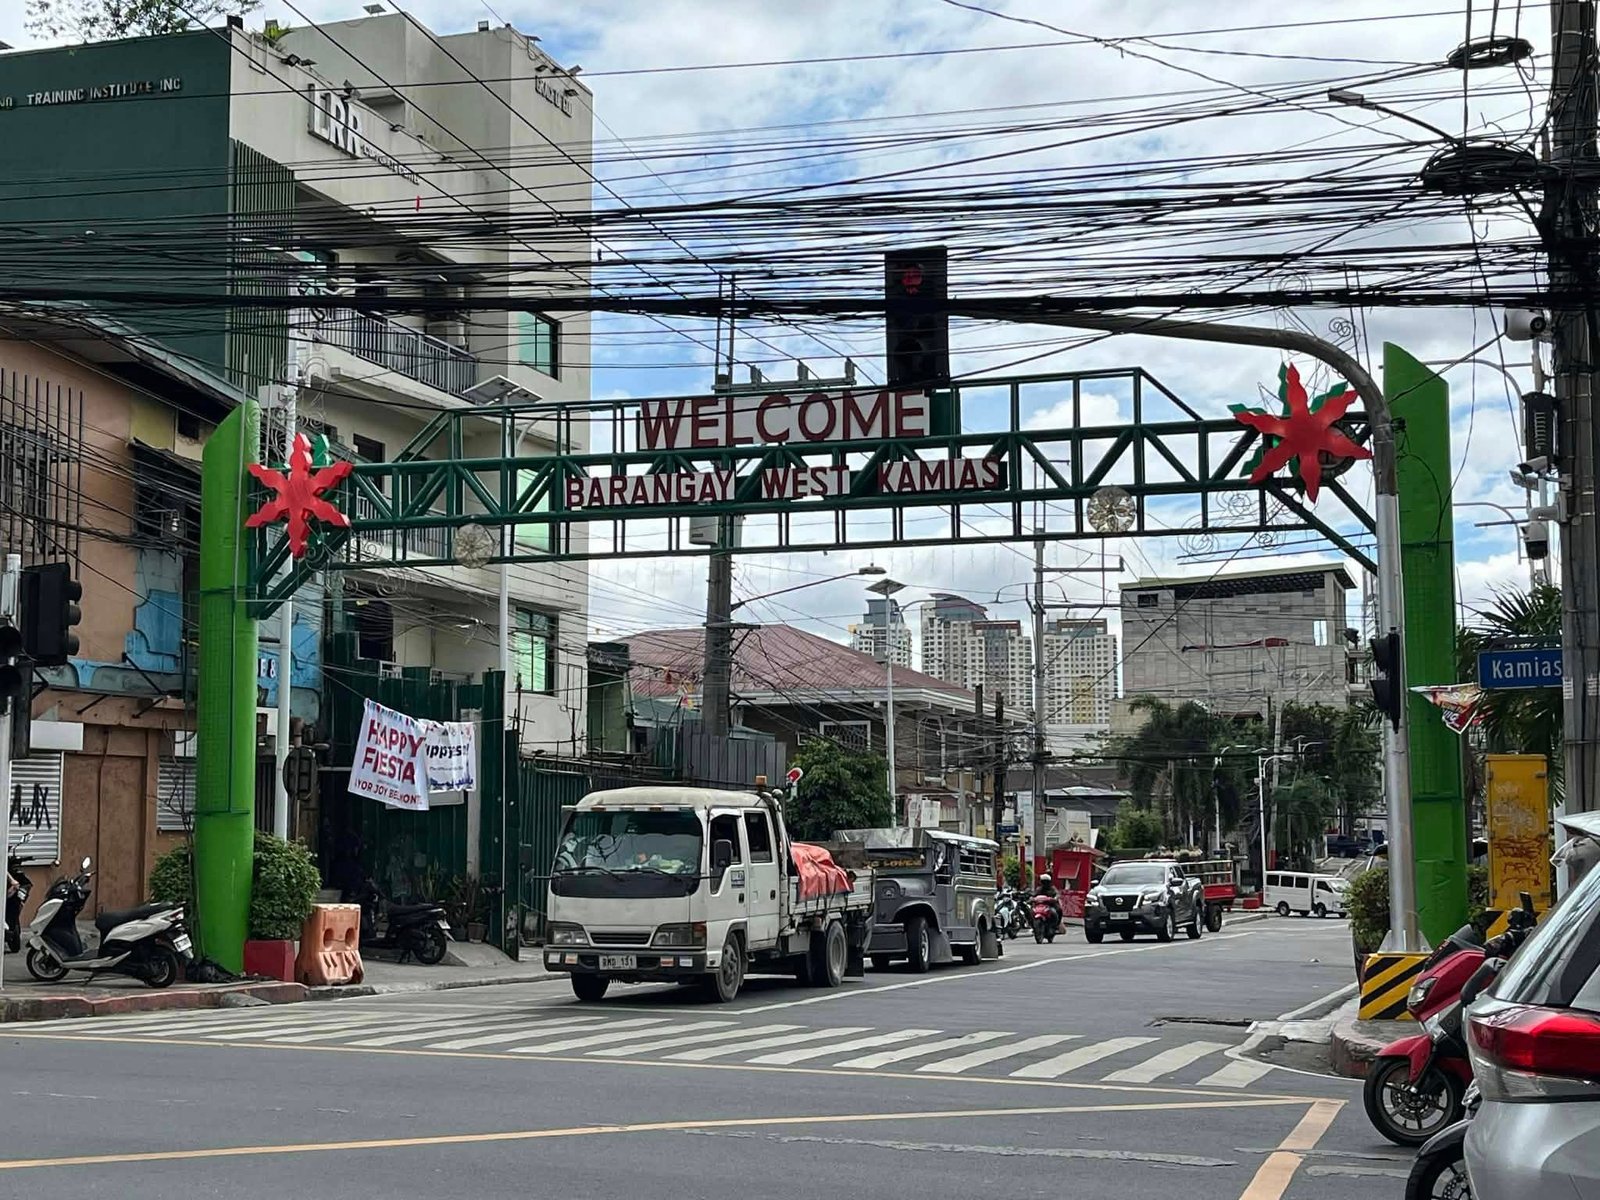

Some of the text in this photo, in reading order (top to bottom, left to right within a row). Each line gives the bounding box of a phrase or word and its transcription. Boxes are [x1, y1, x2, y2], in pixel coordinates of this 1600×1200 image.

[641, 388, 925, 450] WELCOME
[566, 456, 999, 508] BARANGAY WEST KAMIAS
[1492, 656, 1563, 679] Kamias
[367, 719, 426, 758] HAPPY
[361, 747, 416, 785] FIESTA
